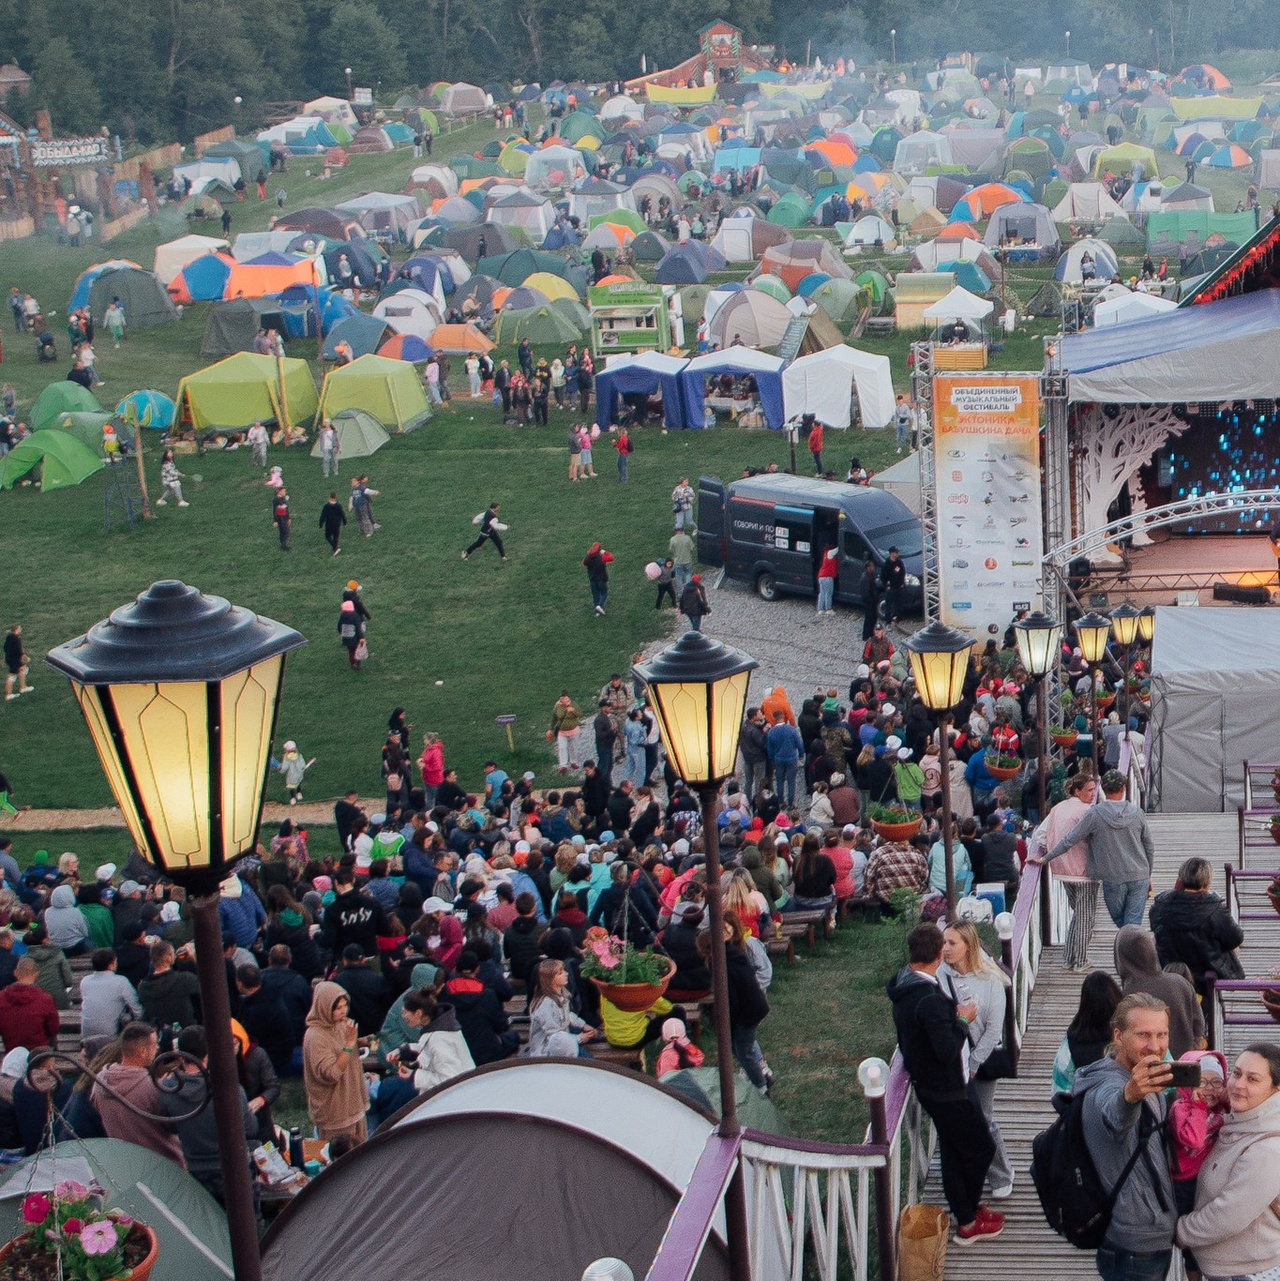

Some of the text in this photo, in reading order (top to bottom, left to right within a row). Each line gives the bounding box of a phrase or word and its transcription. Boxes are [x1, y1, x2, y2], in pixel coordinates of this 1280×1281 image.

[954, 388, 1019, 396] ОБЪЕДИНЕННЫЙ
[955, 395, 1018, 403] МУЗЫКАЛЬНЫЙ
[963, 403, 1010, 411] ФЕСТИВАЛЬ
[958, 416, 1015, 425] ЭКТОНИКА
[942, 426, 1031, 435] БАБУШКИНА ДАЧА
